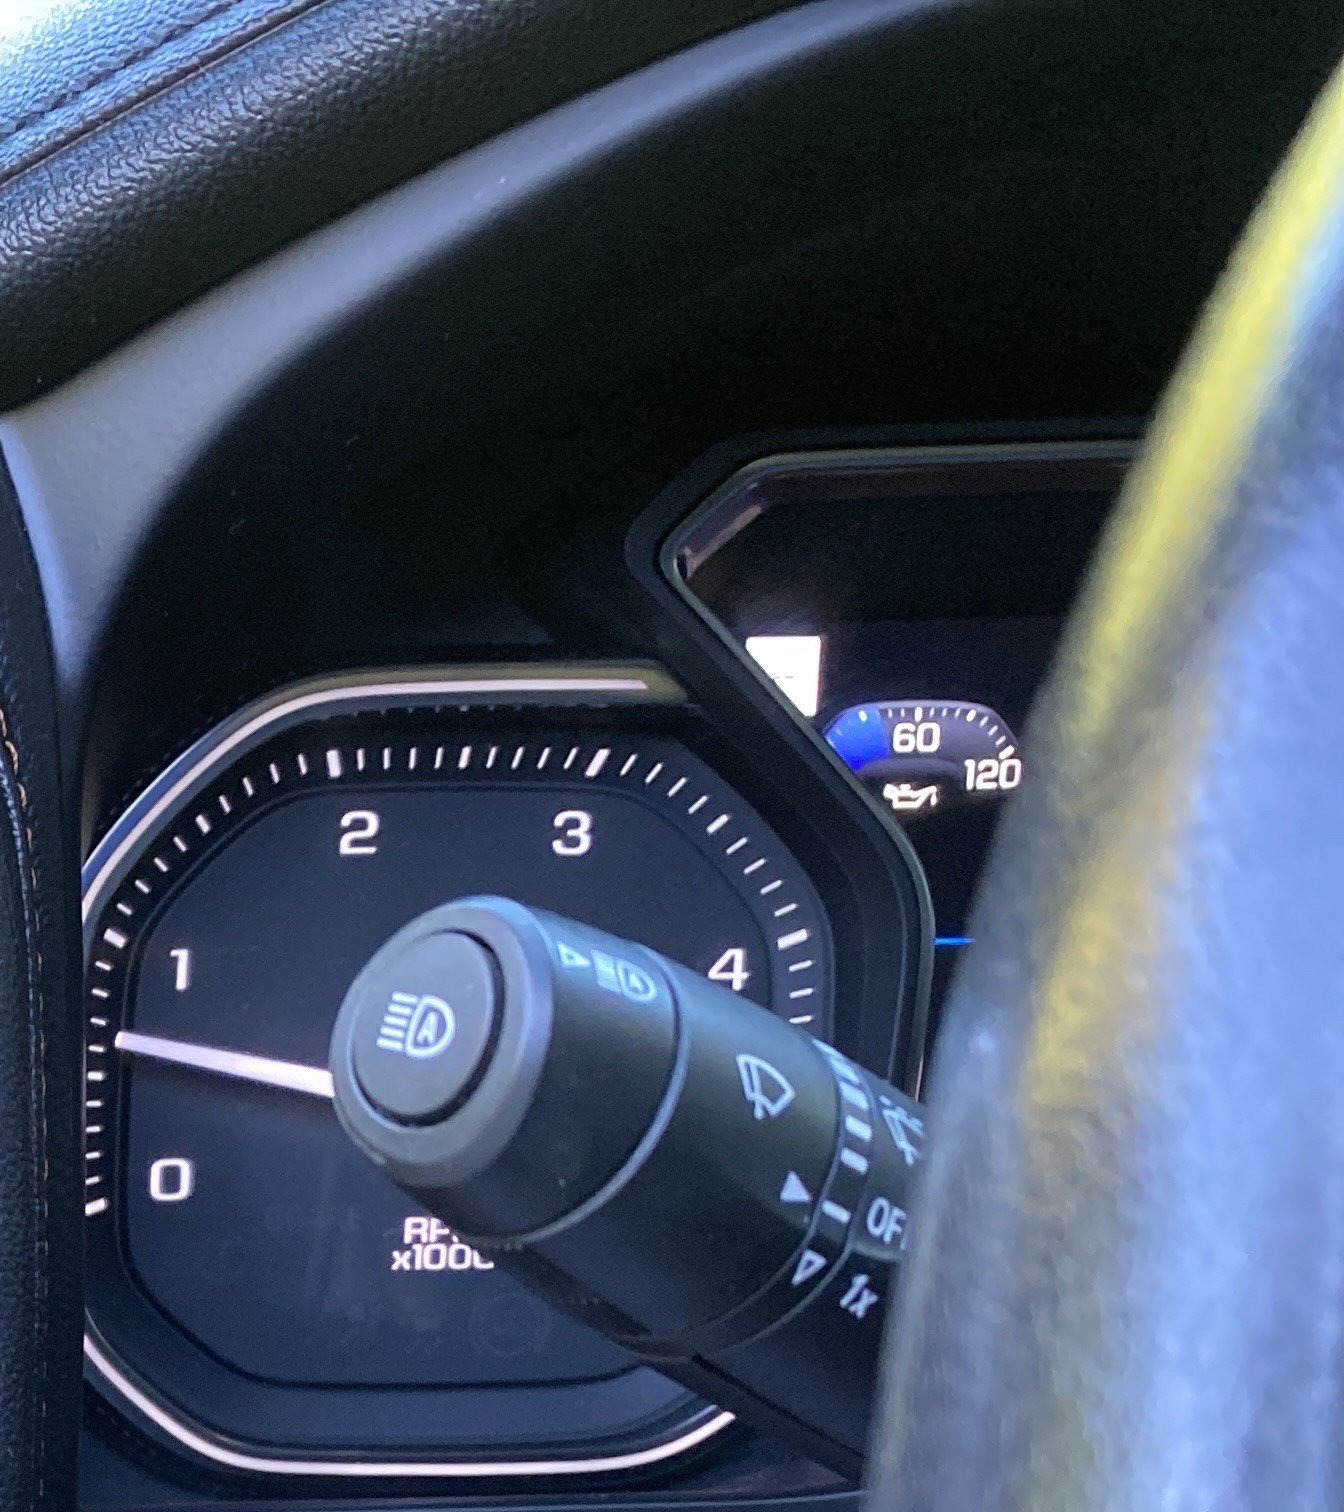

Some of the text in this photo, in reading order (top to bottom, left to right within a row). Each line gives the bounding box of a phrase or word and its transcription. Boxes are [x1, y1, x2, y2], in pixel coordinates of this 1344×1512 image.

[892, 723, 940, 753] 60
[964, 758, 1022, 791] 120
[339, 811, 380, 855] 2
[552, 810, 592, 856] 3
[169, 949, 191, 990] 1
[708, 948, 749, 991] 4
[150, 1158, 192, 1201] 0
[404, 1217, 459, 1243] RP
[867, 1197, 906, 1250] OF
[839, 1274, 879, 1319] 1x
